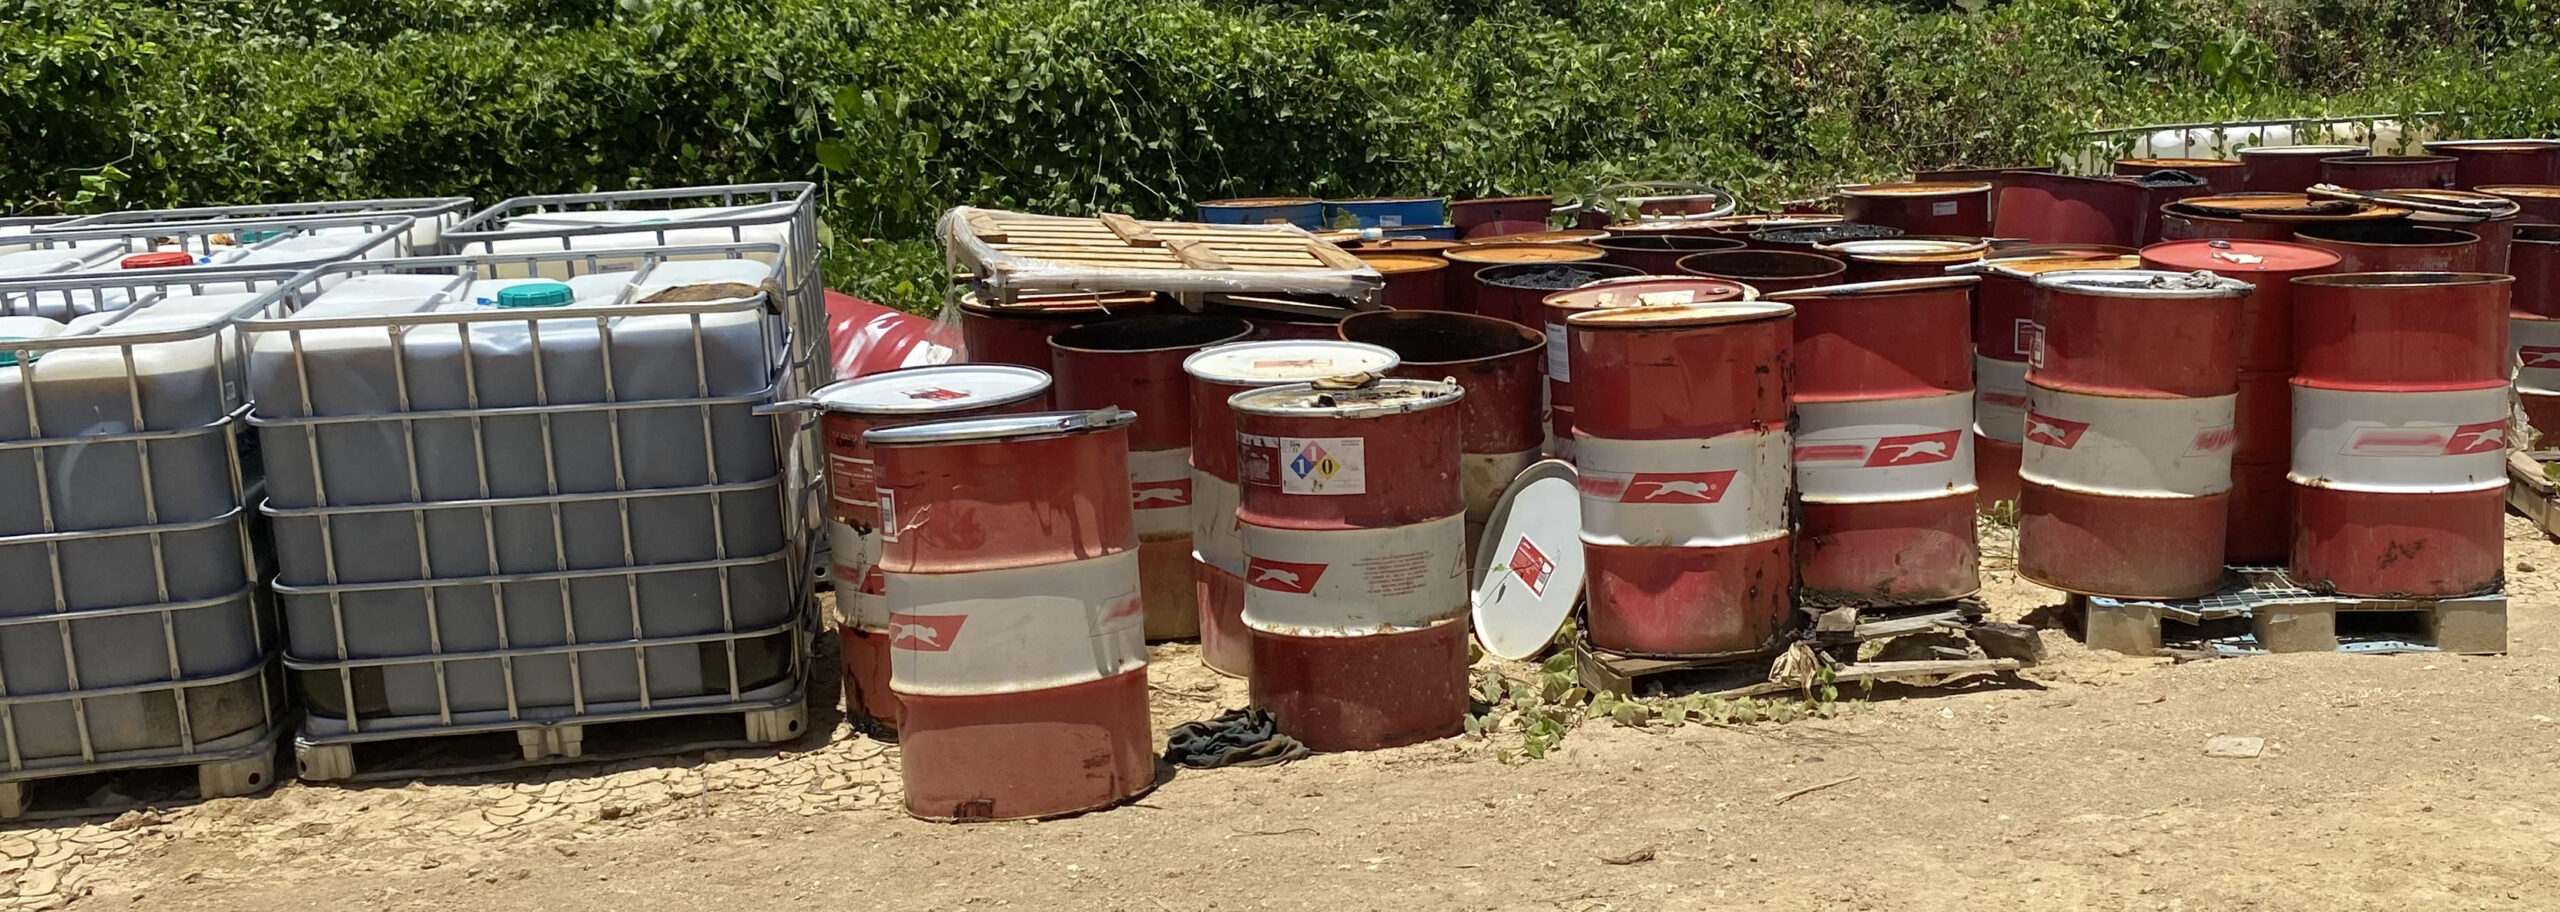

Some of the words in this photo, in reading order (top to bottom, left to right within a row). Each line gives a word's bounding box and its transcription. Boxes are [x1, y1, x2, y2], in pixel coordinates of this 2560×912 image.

[1309, 446, 1319, 462] 1
[1297, 458, 1306, 475] 1
[1322, 458, 1333, 475] 0
